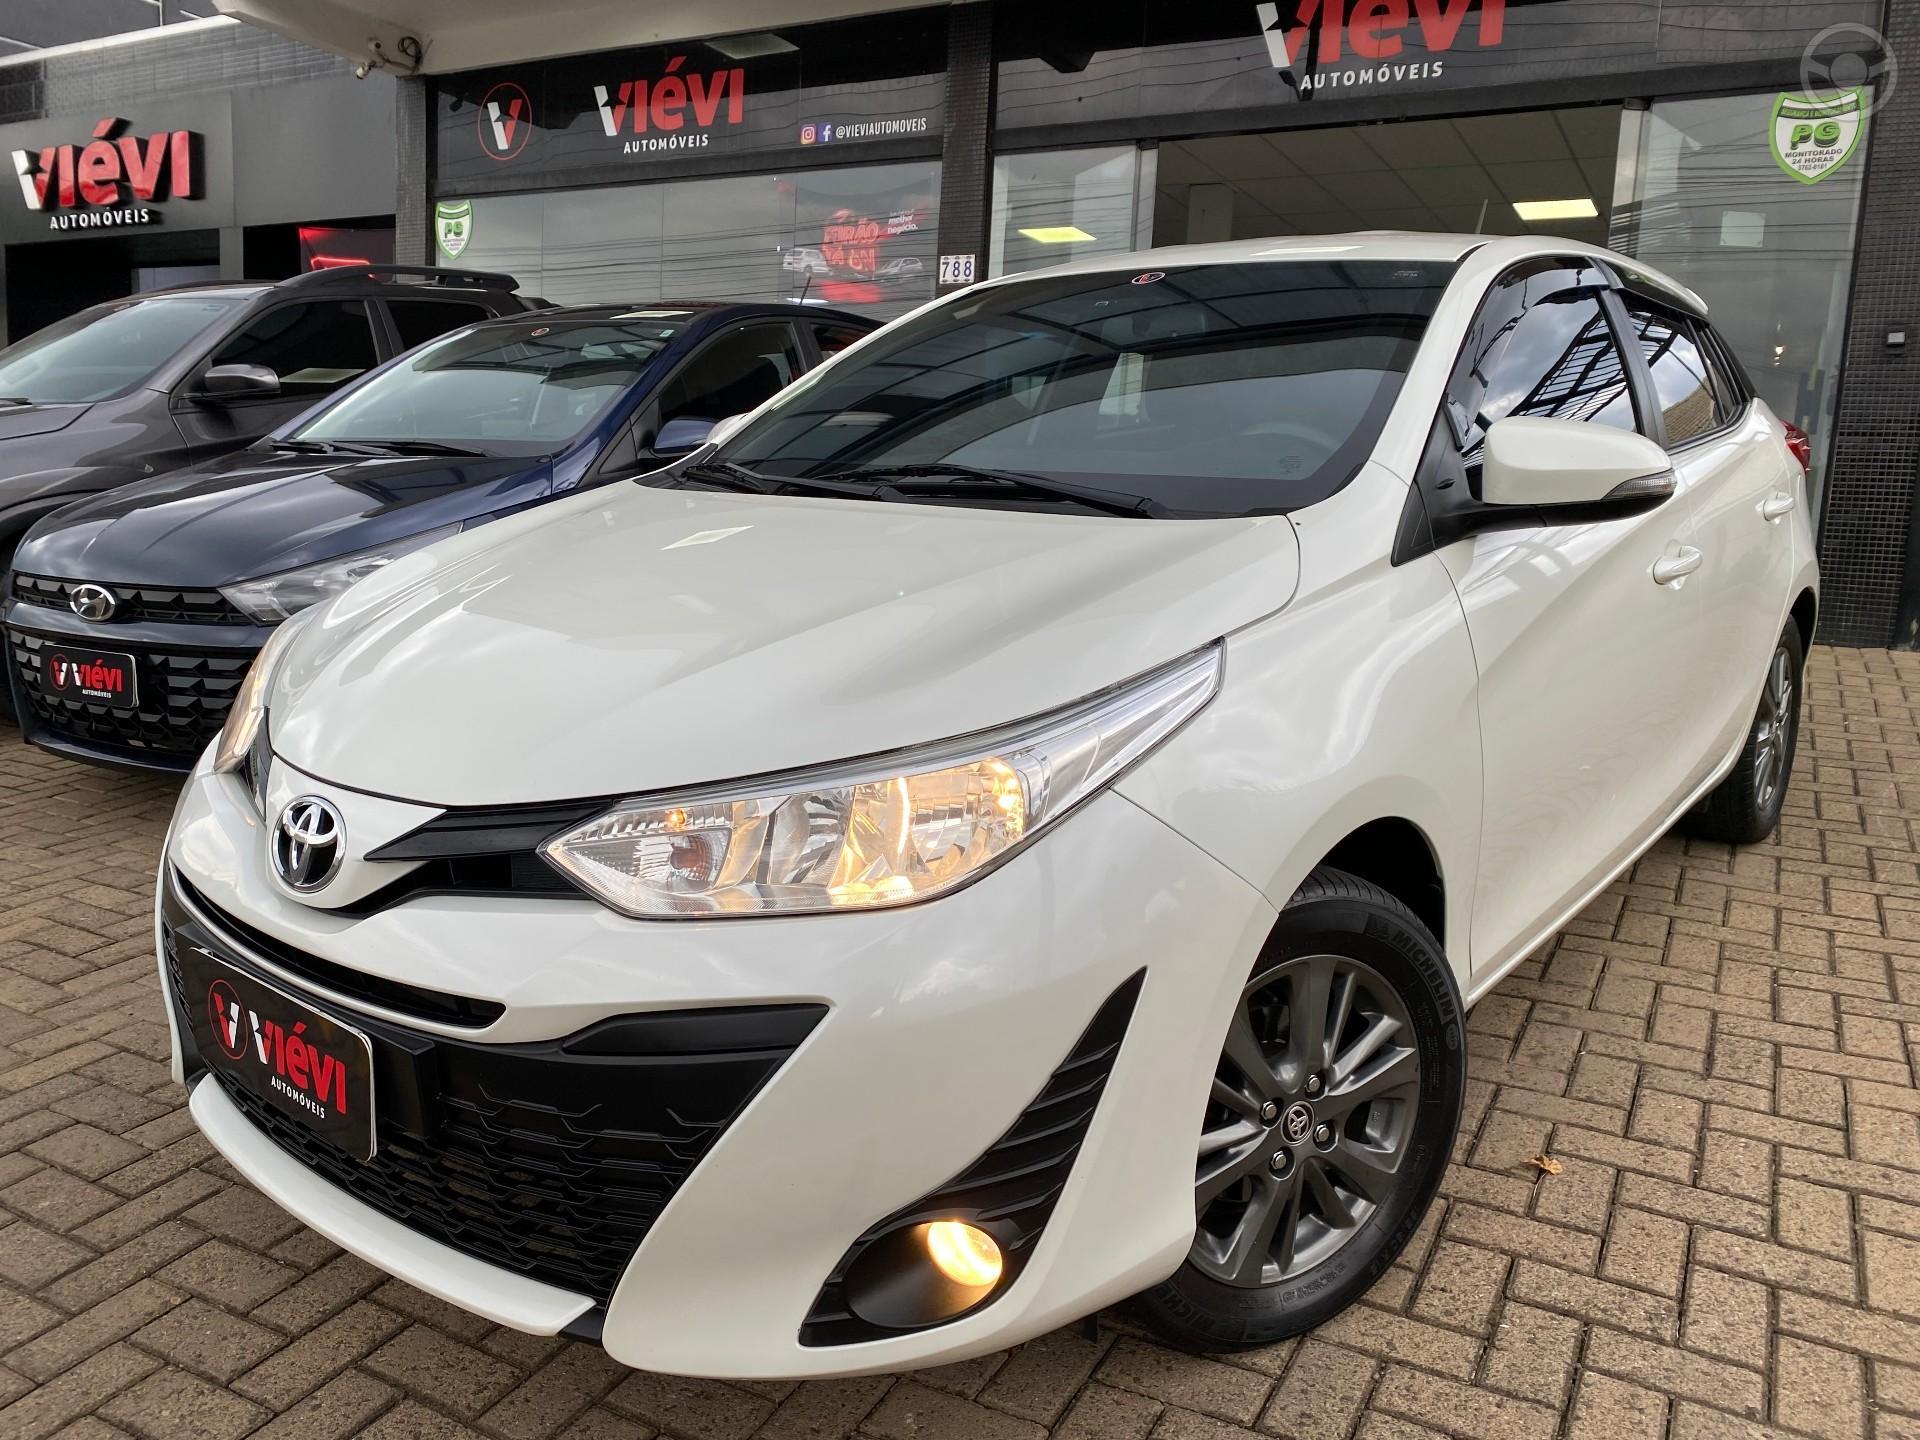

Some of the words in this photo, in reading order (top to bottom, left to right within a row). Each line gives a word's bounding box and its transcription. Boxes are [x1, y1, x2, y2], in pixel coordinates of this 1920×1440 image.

[1300, 61, 1444, 90] AUTOMÓVEIS
[836, 117, 927, 139] @VIEVIAUTOMOVEIS
[623, 134, 709, 154] AUTOMÓVEIS
[1785, 148, 1843, 158] MONITORADO
[1804, 156, 1834, 164] HORAS
[50, 207, 149, 230] AUTOMÓVEIS
[941, 260, 972, 278] 788
[82, 688, 112, 699] AUTOMÓVEIS
[1392, 929, 1456, 1018] MICHELIN
[271, 1075, 326, 1119] AUTOMÓVEIS
